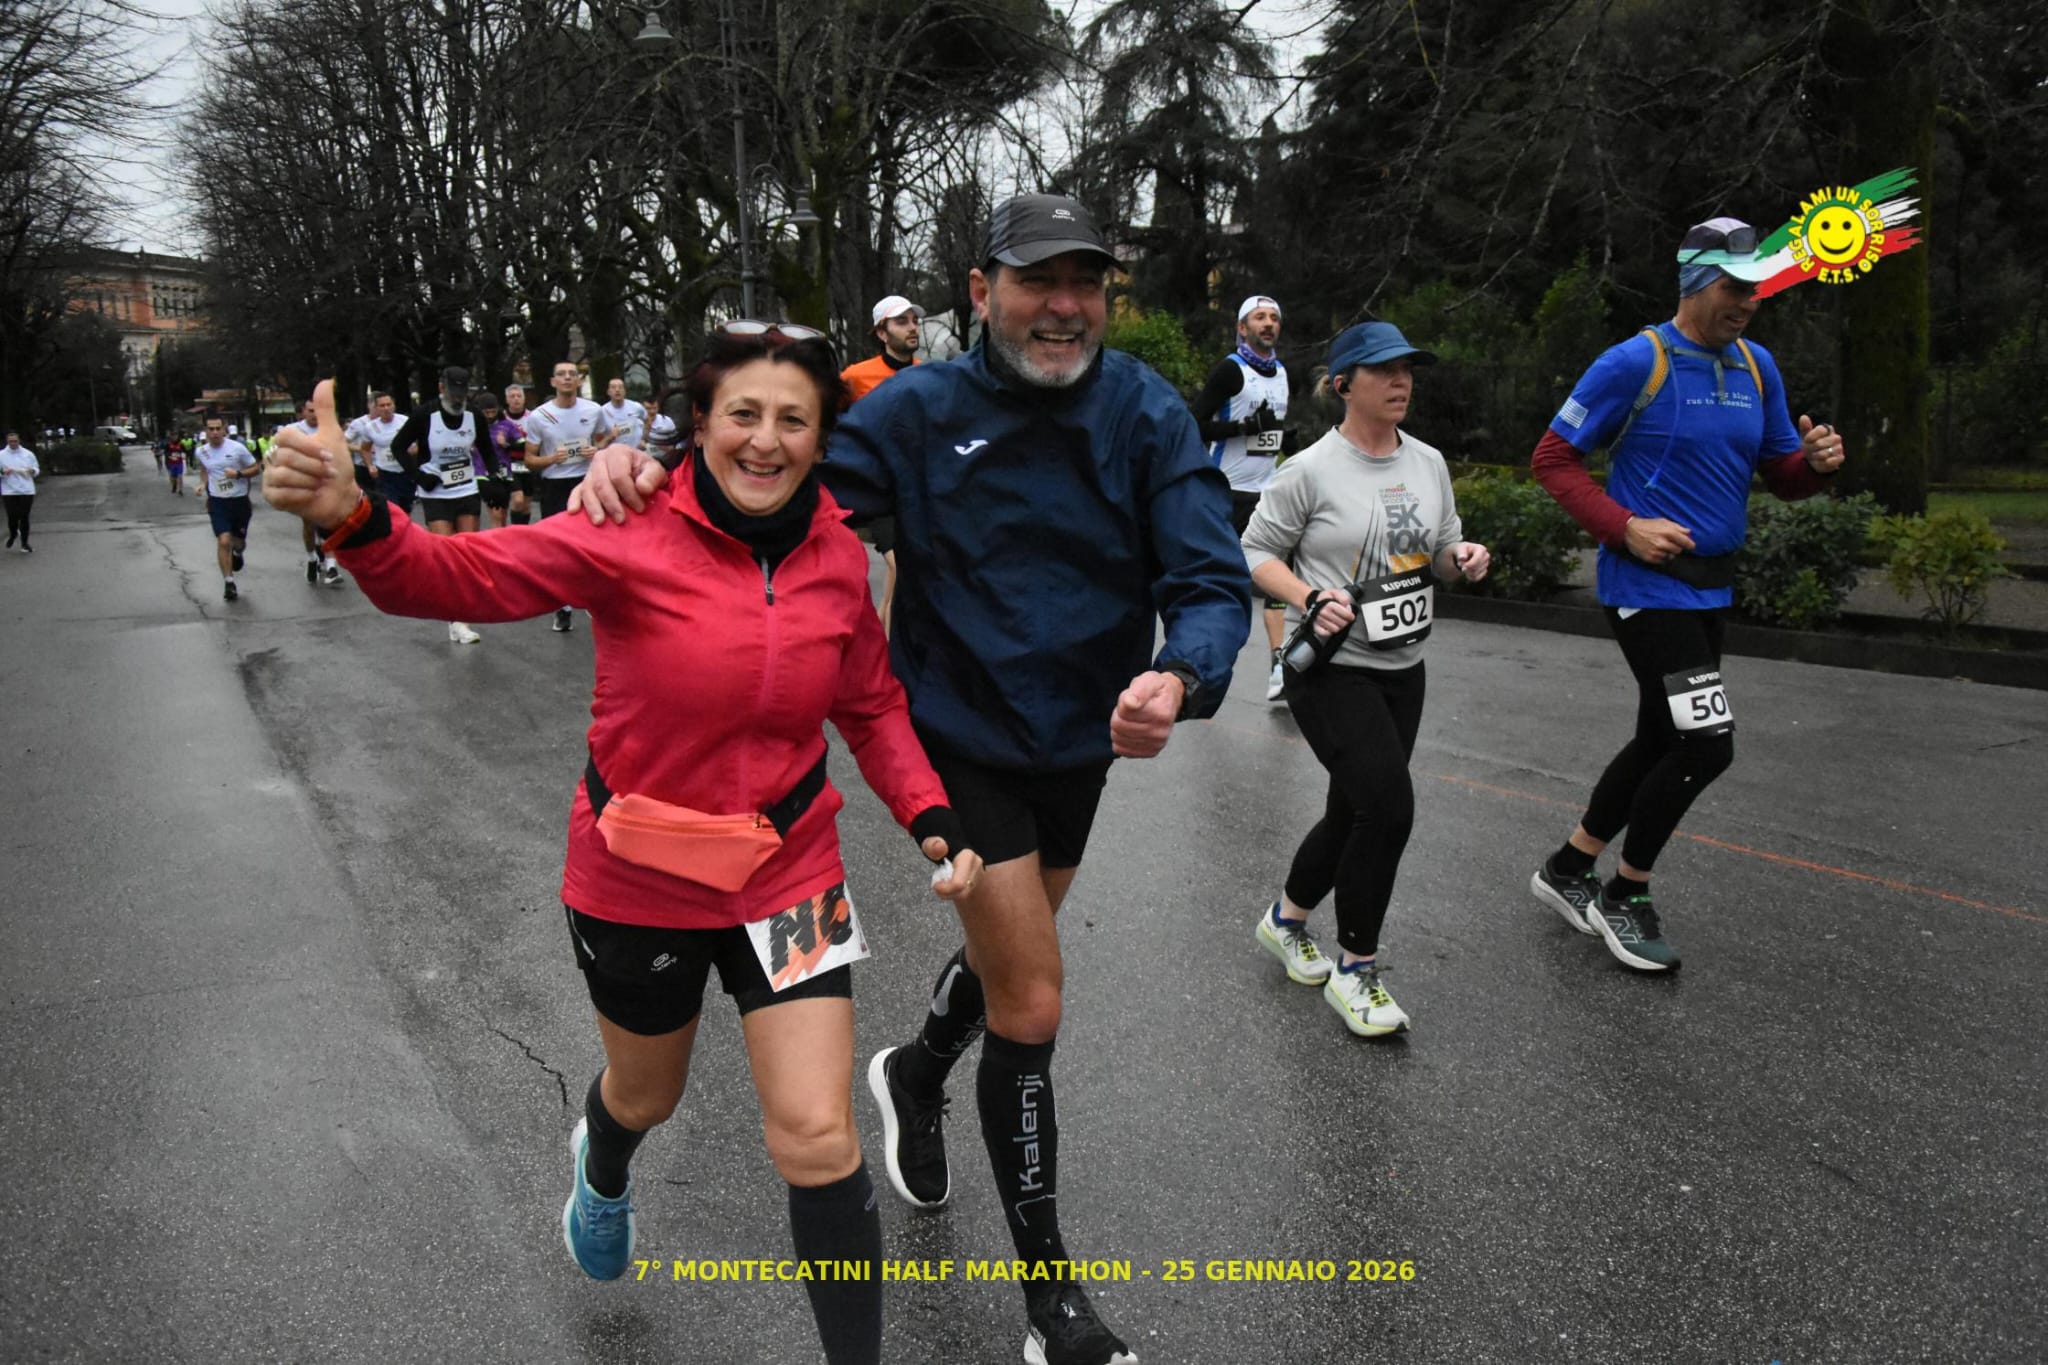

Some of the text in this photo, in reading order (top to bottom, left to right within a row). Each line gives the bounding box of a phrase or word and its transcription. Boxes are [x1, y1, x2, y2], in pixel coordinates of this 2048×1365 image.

[1257, 432, 1279, 447] 551
[450, 470, 465, 481] 69
[1385, 503, 1424, 529] 5K
[1387, 529, 1431, 555] 10K
[1380, 576, 1422, 593] KIPRUN
[1381, 595, 1428, 632] 502
